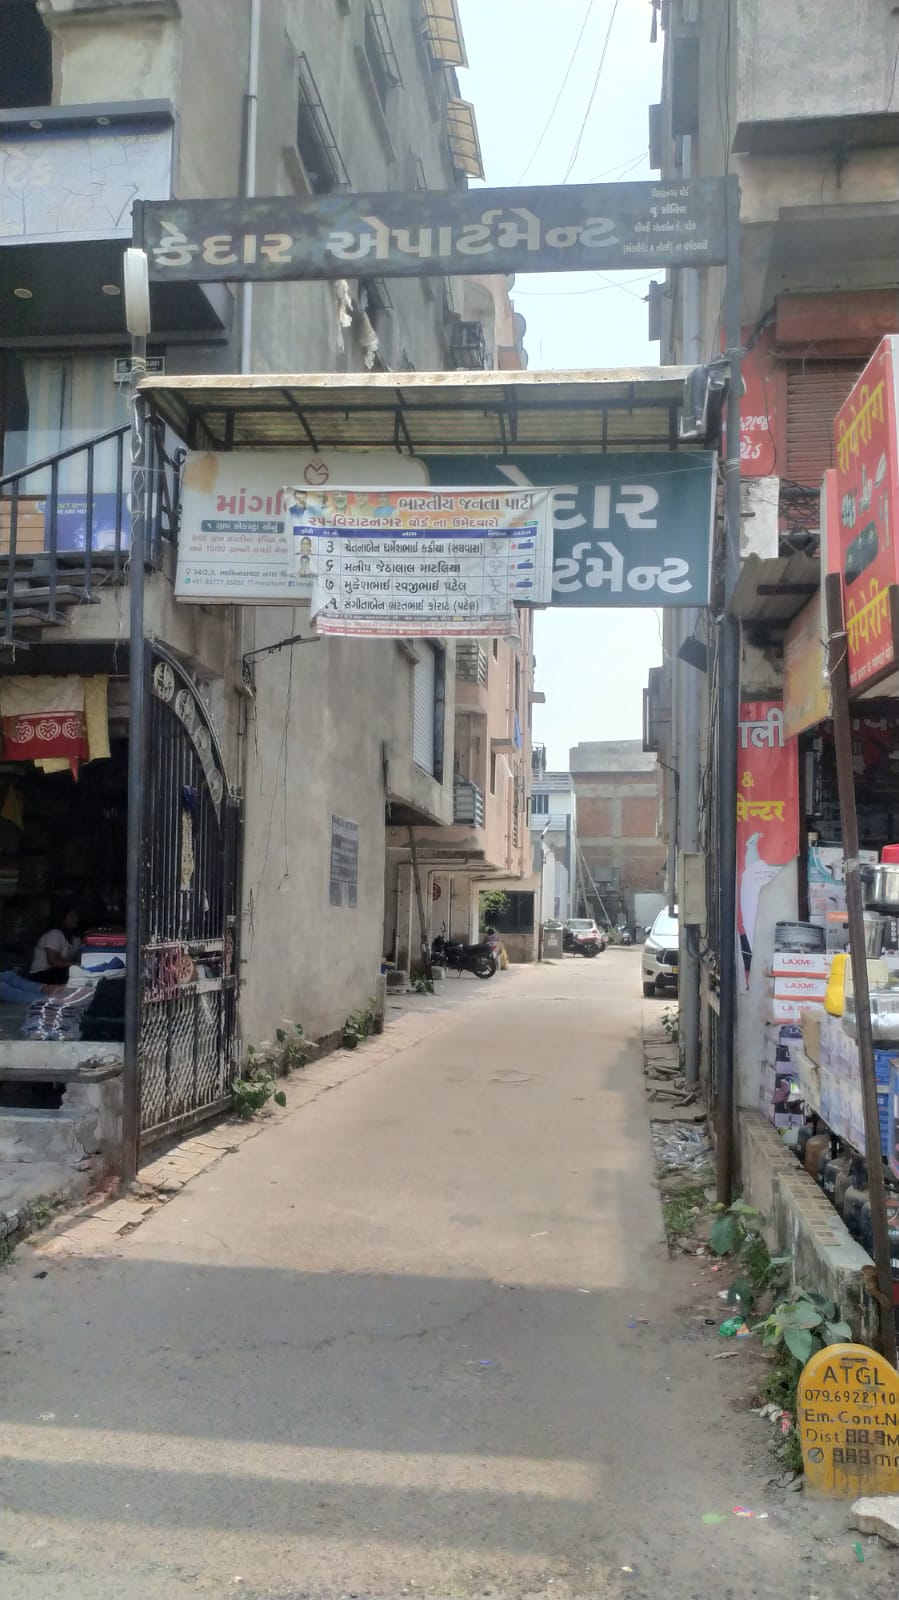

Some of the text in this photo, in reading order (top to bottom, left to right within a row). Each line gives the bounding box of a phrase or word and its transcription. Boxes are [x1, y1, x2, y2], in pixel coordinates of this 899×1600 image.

[153, 208, 620, 266] કેદાર એપાર્ટમેન્ટ
[398, 493, 534, 511] ભારતીય જનતા પાર્ટી
[433, 519, 446, 527] ના
[452, 518, 499, 528] ઉમેદવારો
[375, 559, 415, 573] જેઠાલાલ
[419, 560, 461, 573] માટલિયા
[344, 578, 390, 593] મુકેશભાઈ
[395, 579, 440, 593] રવજીભાઈ
[443, 578, 466, 591] પટેલ
[344, 597, 385, 610] સંગીતાબેન
[741, 771, 755, 788] &
[782, 958, 811, 966] LAXMI
[785, 982, 814, 990] LAXMI
[823, 1365, 886, 1386] ATGL
[804, 1409, 835, 1423] Em.
